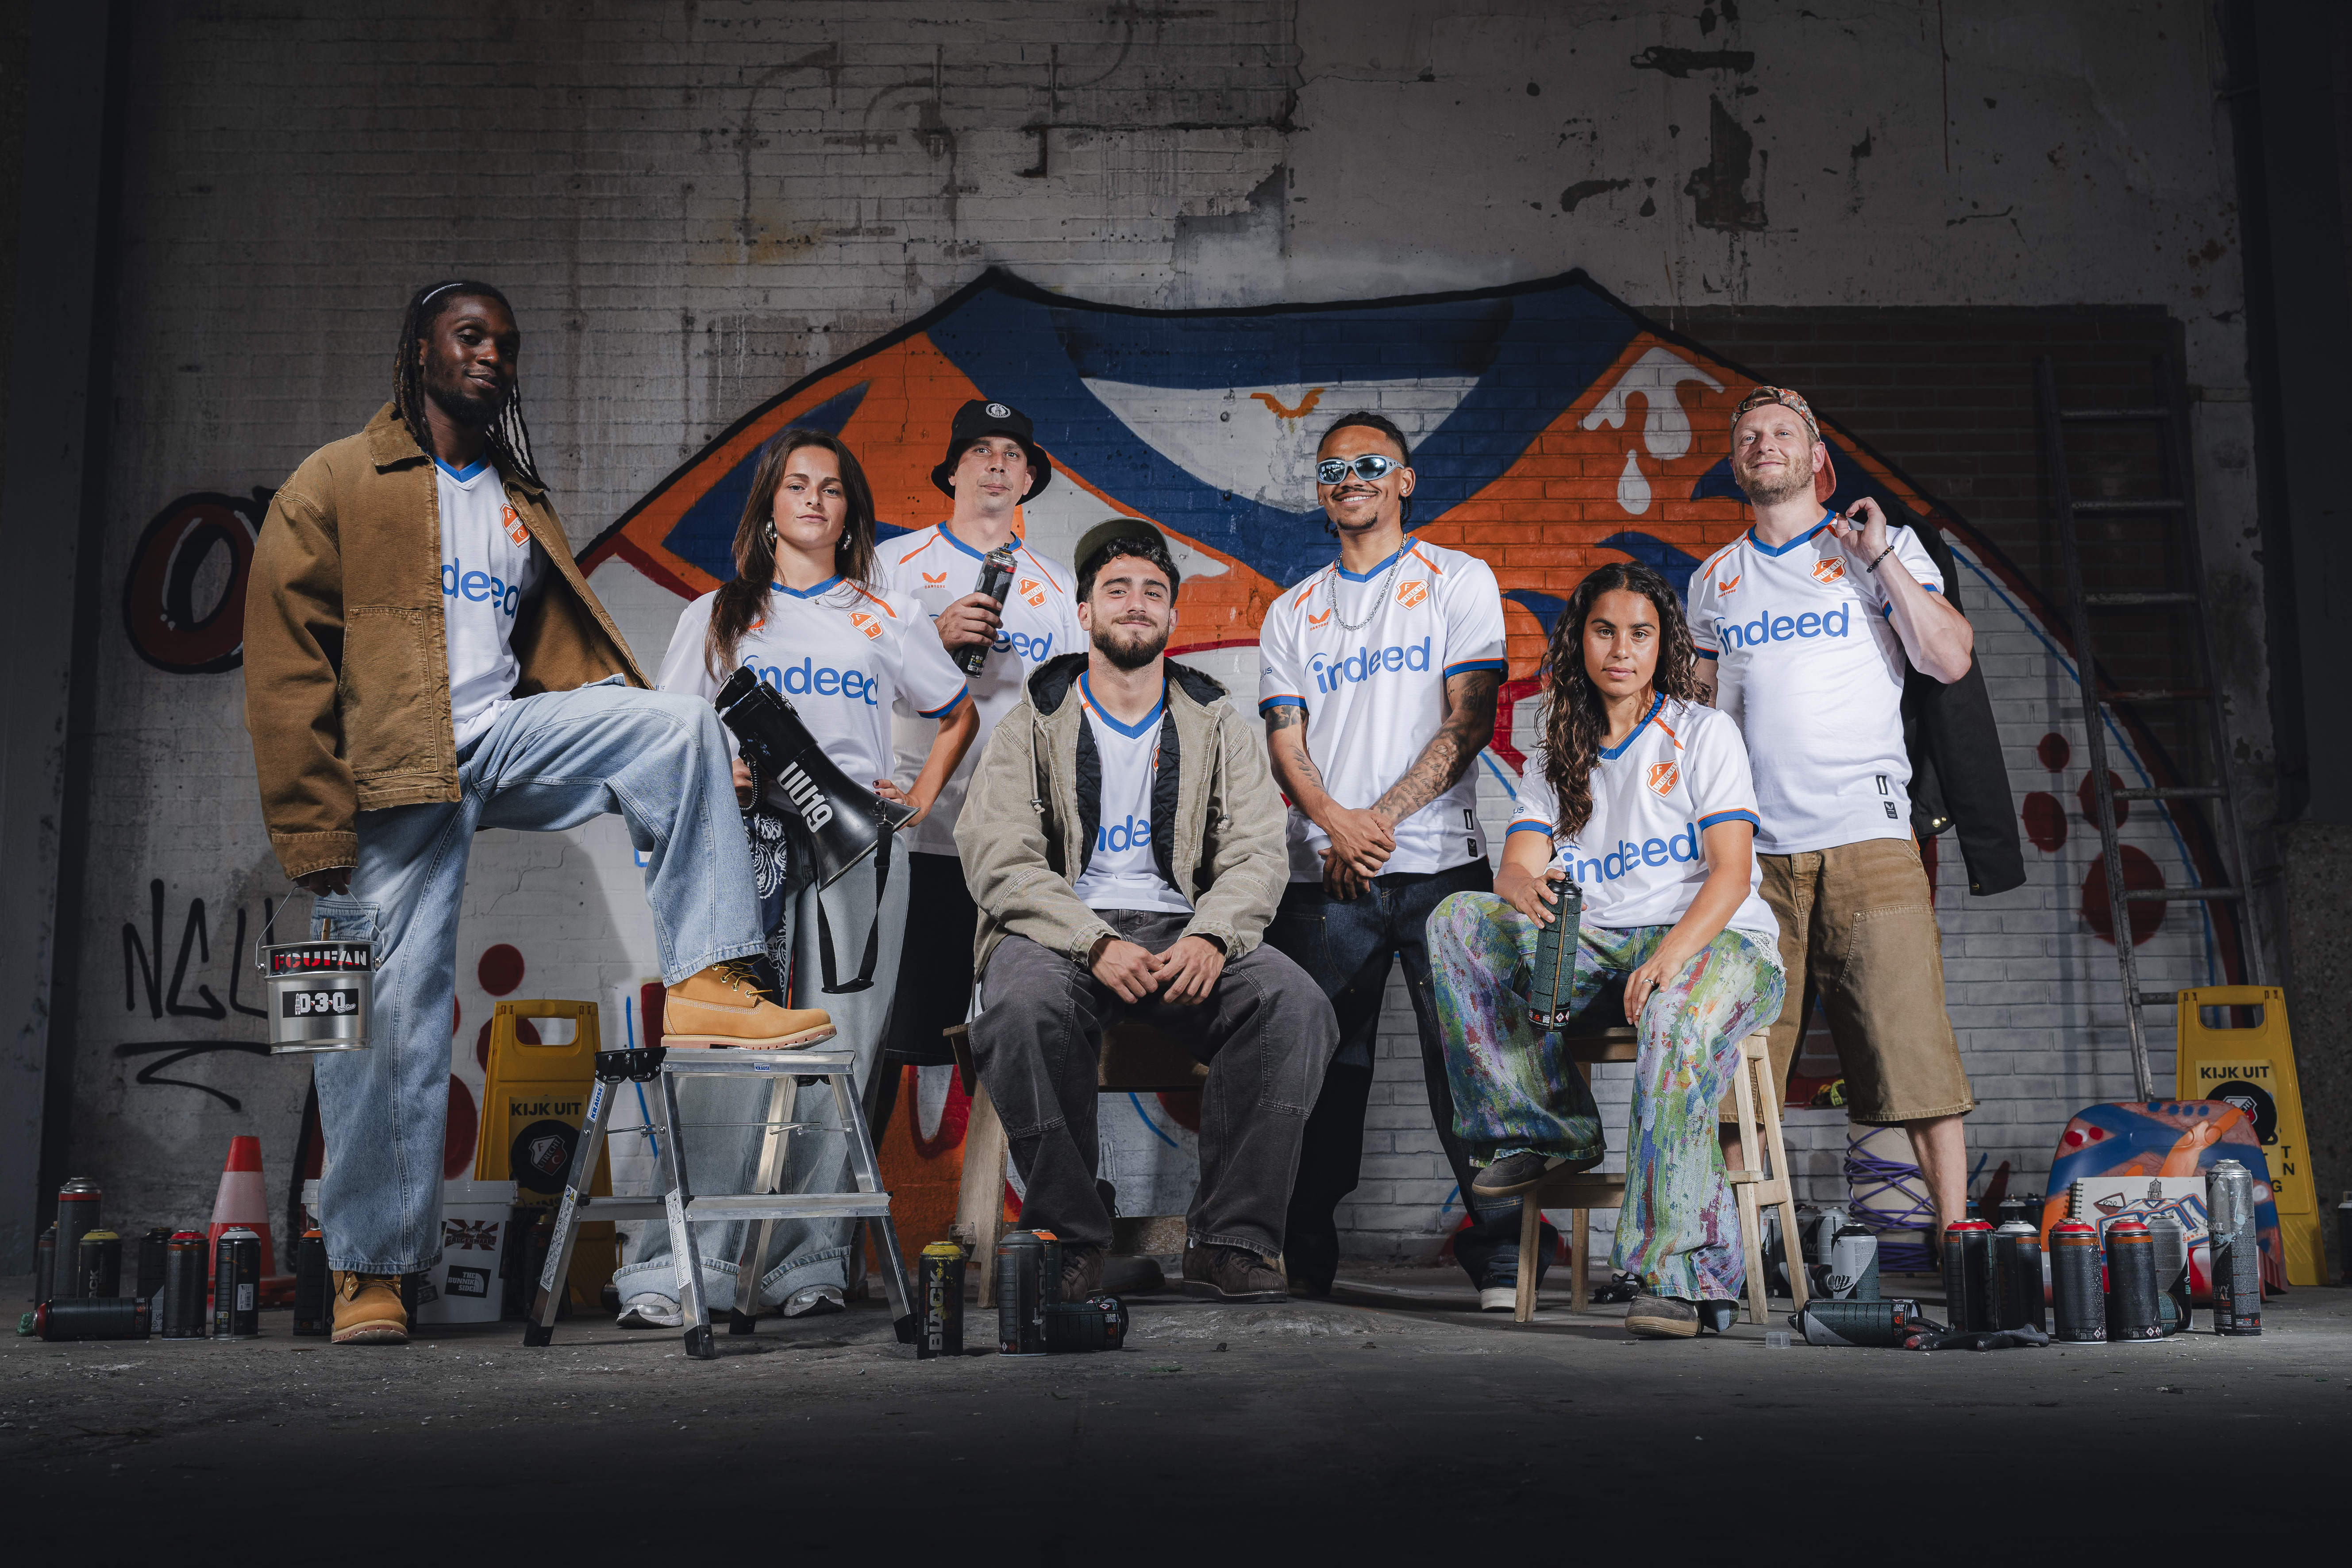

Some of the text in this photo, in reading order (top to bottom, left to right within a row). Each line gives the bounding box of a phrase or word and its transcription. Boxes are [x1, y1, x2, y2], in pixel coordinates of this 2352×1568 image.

[507, 509, 512, 519] F
[517, 529, 524, 539] C
[1816, 558, 1842, 580] UTRECHT
[441, 557, 523, 619] deed
[1024, 584, 1043, 600] UTRECHT
[1400, 582, 1426, 604] UTRECHT
[861, 617, 877, 631] UTRECHT
[1714, 602, 1849, 656] indeed
[991, 630, 1052, 662] eed
[1305, 636, 1430, 694] indeed
[1653, 762, 1677, 791] UTRECHT
[1656, 766, 1663, 775] F
[1667, 778, 1674, 787] C
[777, 761, 833, 833] UU19
[1557, 822, 1699, 883] indeed
[2201, 1066, 2269, 1079] KIJK UIT
[511, 1102, 581, 1116] KIJK UIT
[591, 1084, 603, 1119] KRAUSE
[538, 1142, 543, 1152] F
[538, 1138, 561, 1171] UTRECHT
[552, 1154, 560, 1165] C
[446, 1236, 495, 1245] GALGENWAARD
[89, 1270, 99, 1298] ACK
[929, 1270, 944, 1350] BLACK
